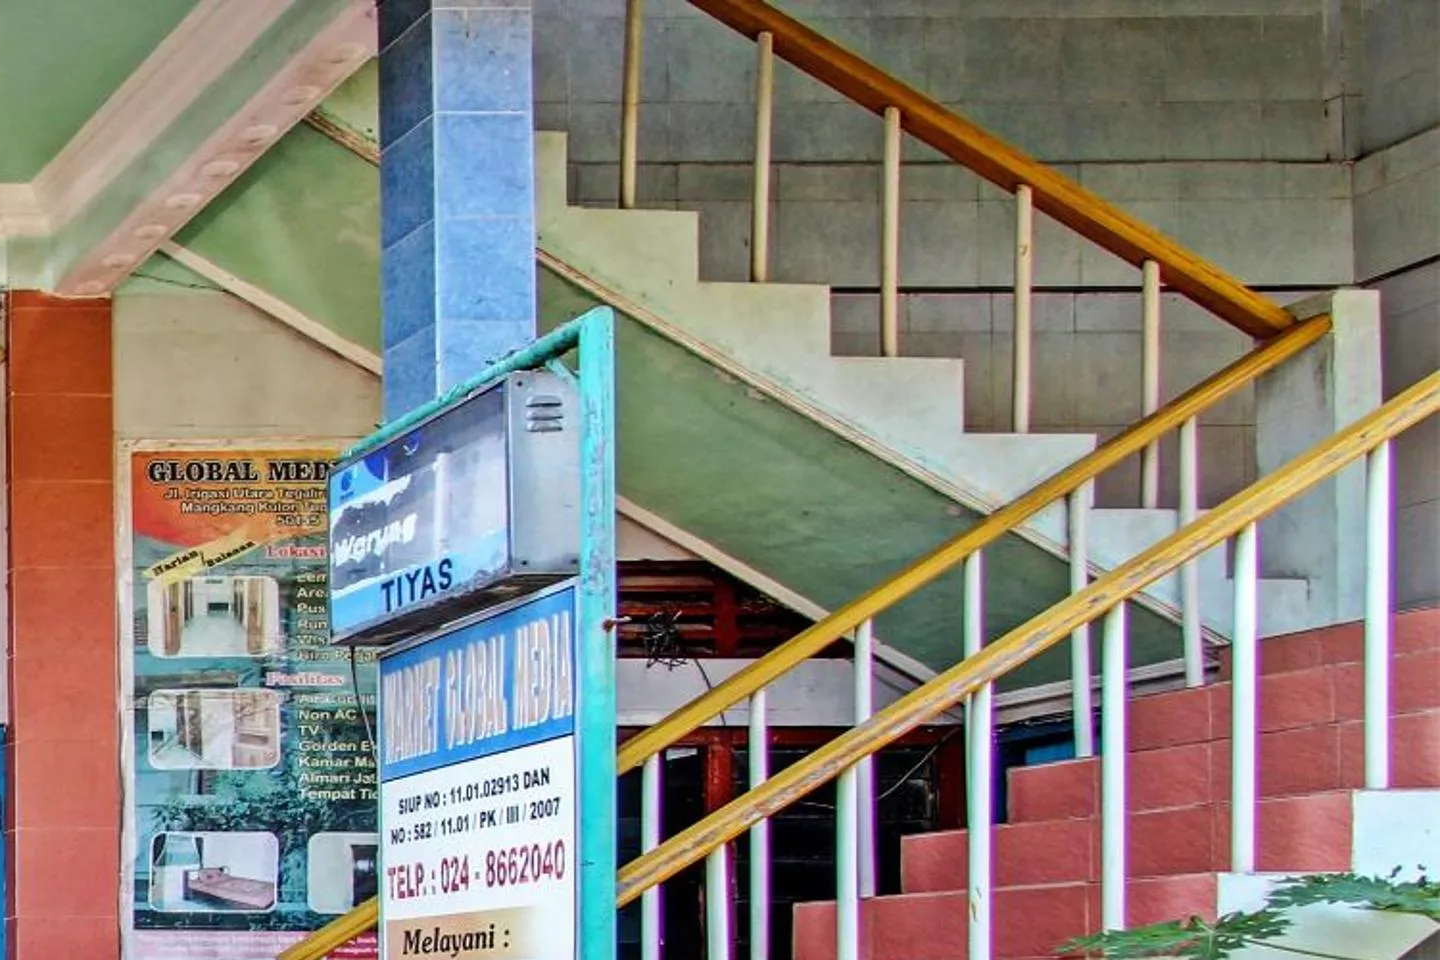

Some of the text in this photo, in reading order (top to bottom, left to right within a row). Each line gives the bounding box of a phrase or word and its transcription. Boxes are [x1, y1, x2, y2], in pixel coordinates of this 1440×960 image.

[148, 462, 258, 482] GLOBAL
[181, 502, 255, 514] Mangkang
[381, 557, 453, 613] TIYAS
[512, 611, 572, 731] MEDIA
[299, 709, 357, 720] Non AC
[298, 725, 320, 736] TV
[299, 741, 357, 751] Gorden
[299, 757, 352, 767] Kamar
[300, 772, 350, 783] Almari
[299, 788, 355, 800] Tempat
[398, 796, 421, 815] SIUP
[424, 793, 441, 809] NO
[450, 776, 520, 805] 11.01.02913
[523, 767, 551, 790] DAN
[391, 828, 405, 845] NO
[413, 822, 432, 841] 582
[440, 815, 470, 836] 11.01
[479, 811, 497, 829] PK
[530, 797, 561, 820] 2007
[388, 862, 427, 901] TELP.
[440, 855, 469, 894] 024
[485, 838, 566, 888] 8662040
[403, 924, 496, 956] Melayani
